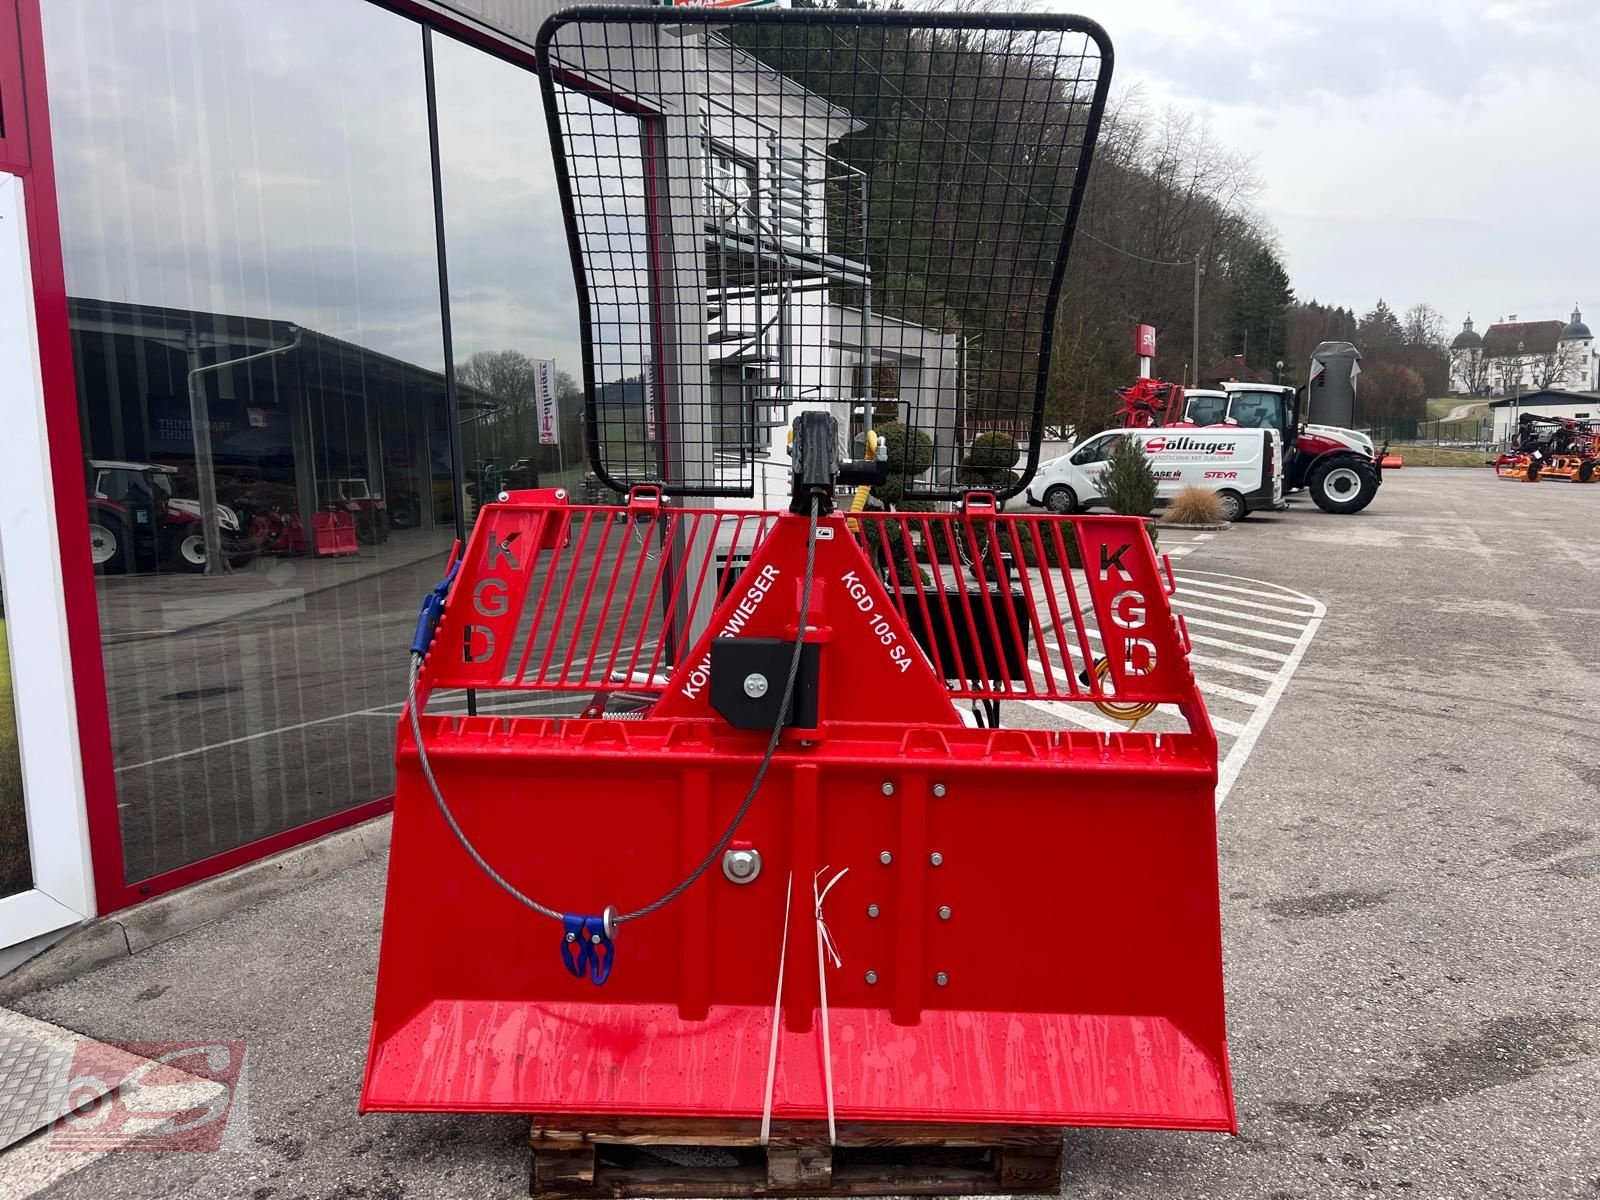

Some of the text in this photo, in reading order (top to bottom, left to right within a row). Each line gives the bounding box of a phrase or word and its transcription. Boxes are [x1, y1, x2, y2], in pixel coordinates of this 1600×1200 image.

[1145, 437, 1236, 455] Söllinger
[681, 564, 780, 699] KÖNSWIESER
[841, 571, 912, 673] KGD 105 SA
